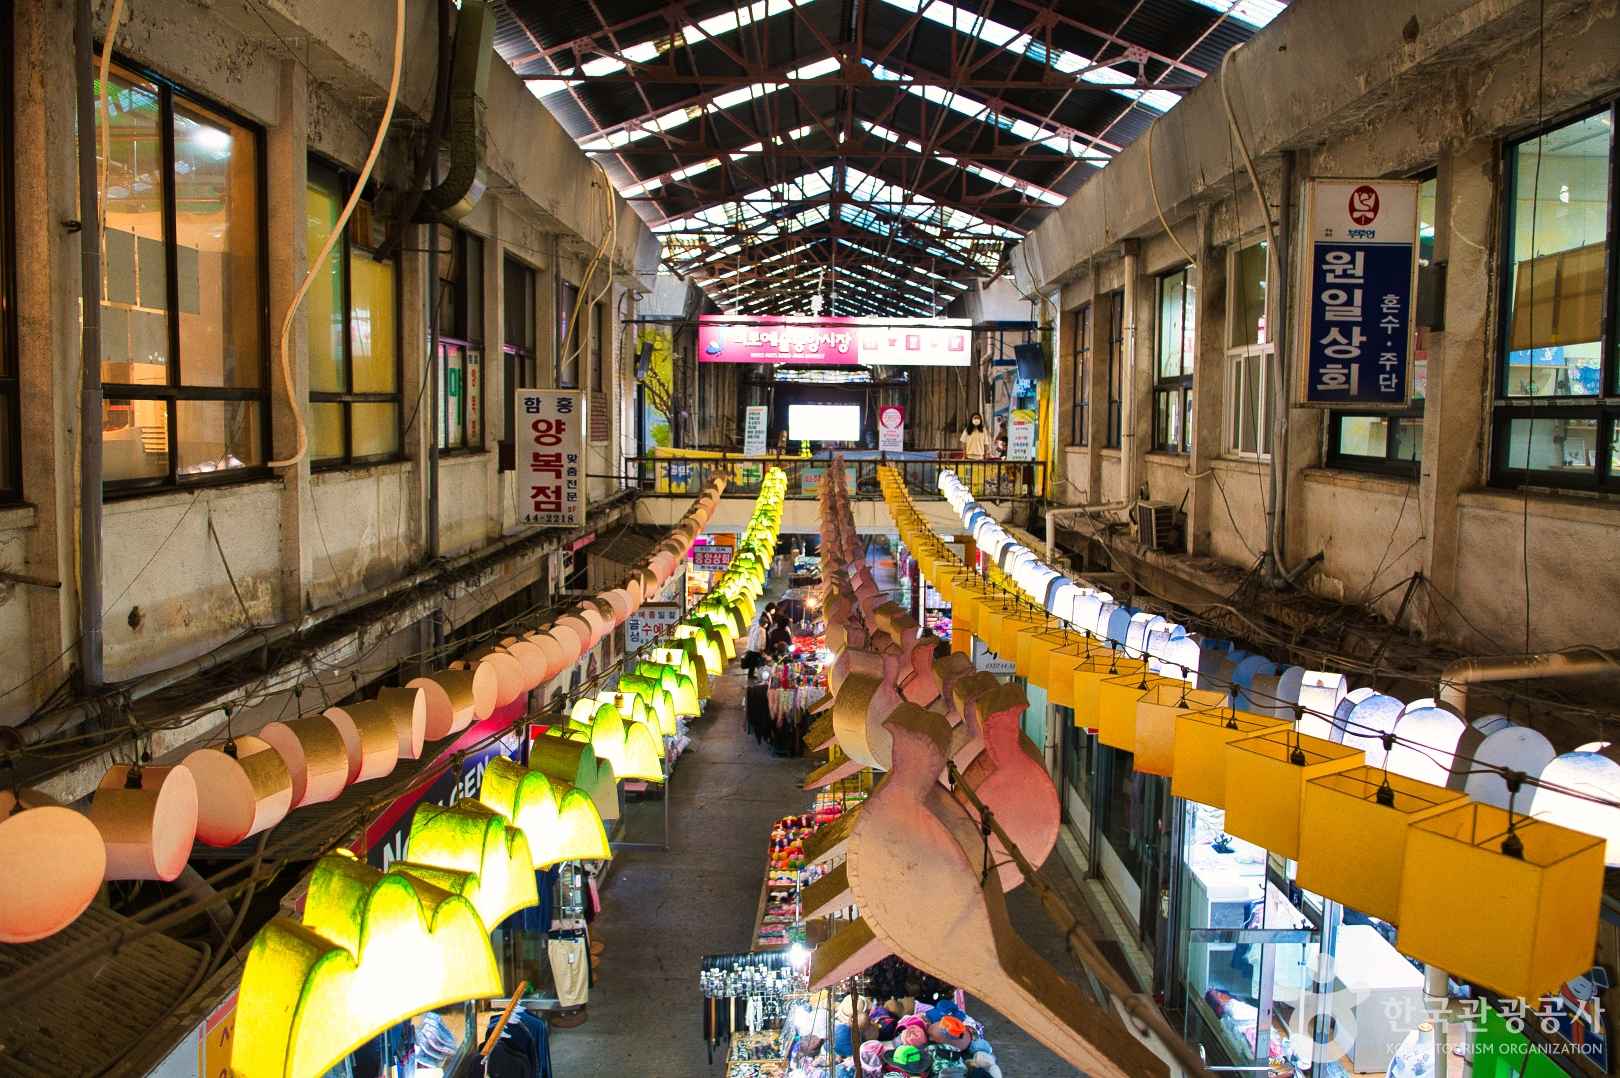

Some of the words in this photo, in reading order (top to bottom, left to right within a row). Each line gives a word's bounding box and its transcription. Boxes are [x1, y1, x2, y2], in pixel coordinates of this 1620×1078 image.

[1316, 251, 1367, 396] 원일상회
[524, 397, 574, 414] 함흥
[530, 419, 565, 512] 양복점
[566, 453, 578, 502] 맞춤전문
